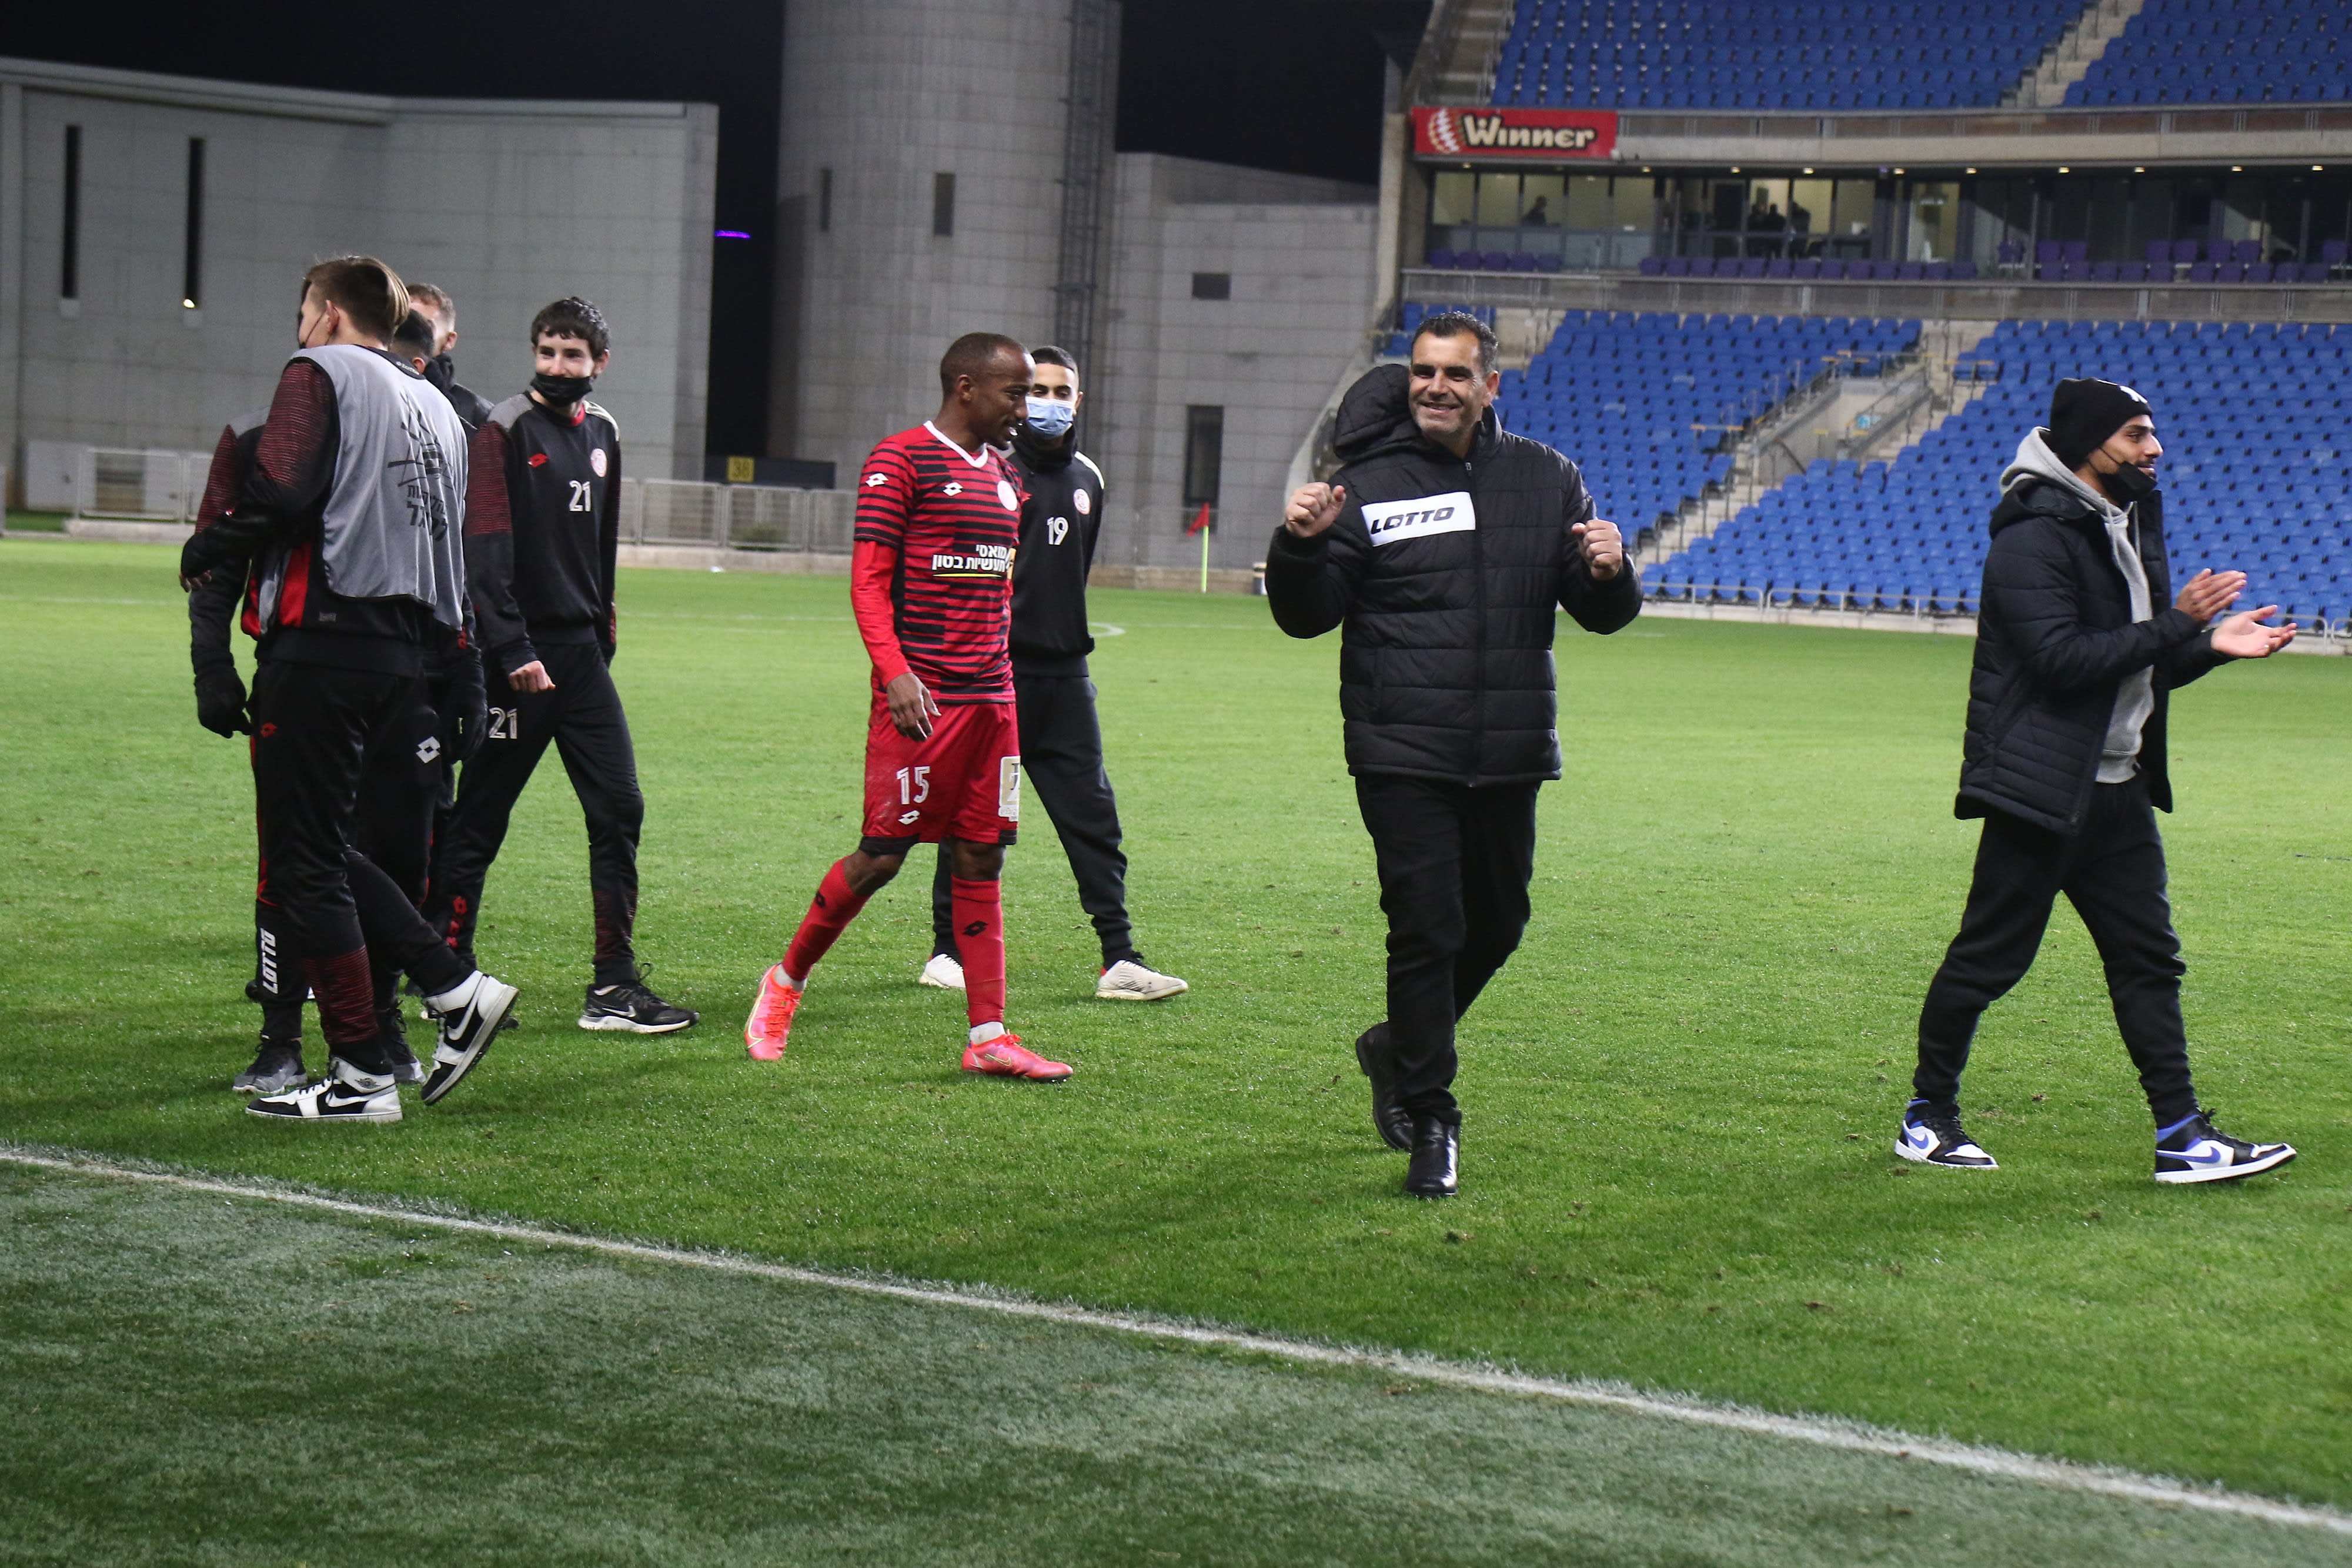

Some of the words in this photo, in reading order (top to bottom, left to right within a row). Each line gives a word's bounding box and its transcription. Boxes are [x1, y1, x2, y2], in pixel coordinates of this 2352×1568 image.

[1464, 115, 1596, 149] Winner
[569, 480, 591, 511] 21
[1047, 517, 1068, 545] 19
[1371, 507, 1455, 534] LOTTO
[932, 554, 964, 570] בטון
[489, 707, 517, 738] 21
[897, 766, 930, 804] 15
[260, 928, 278, 994] LOTTO
